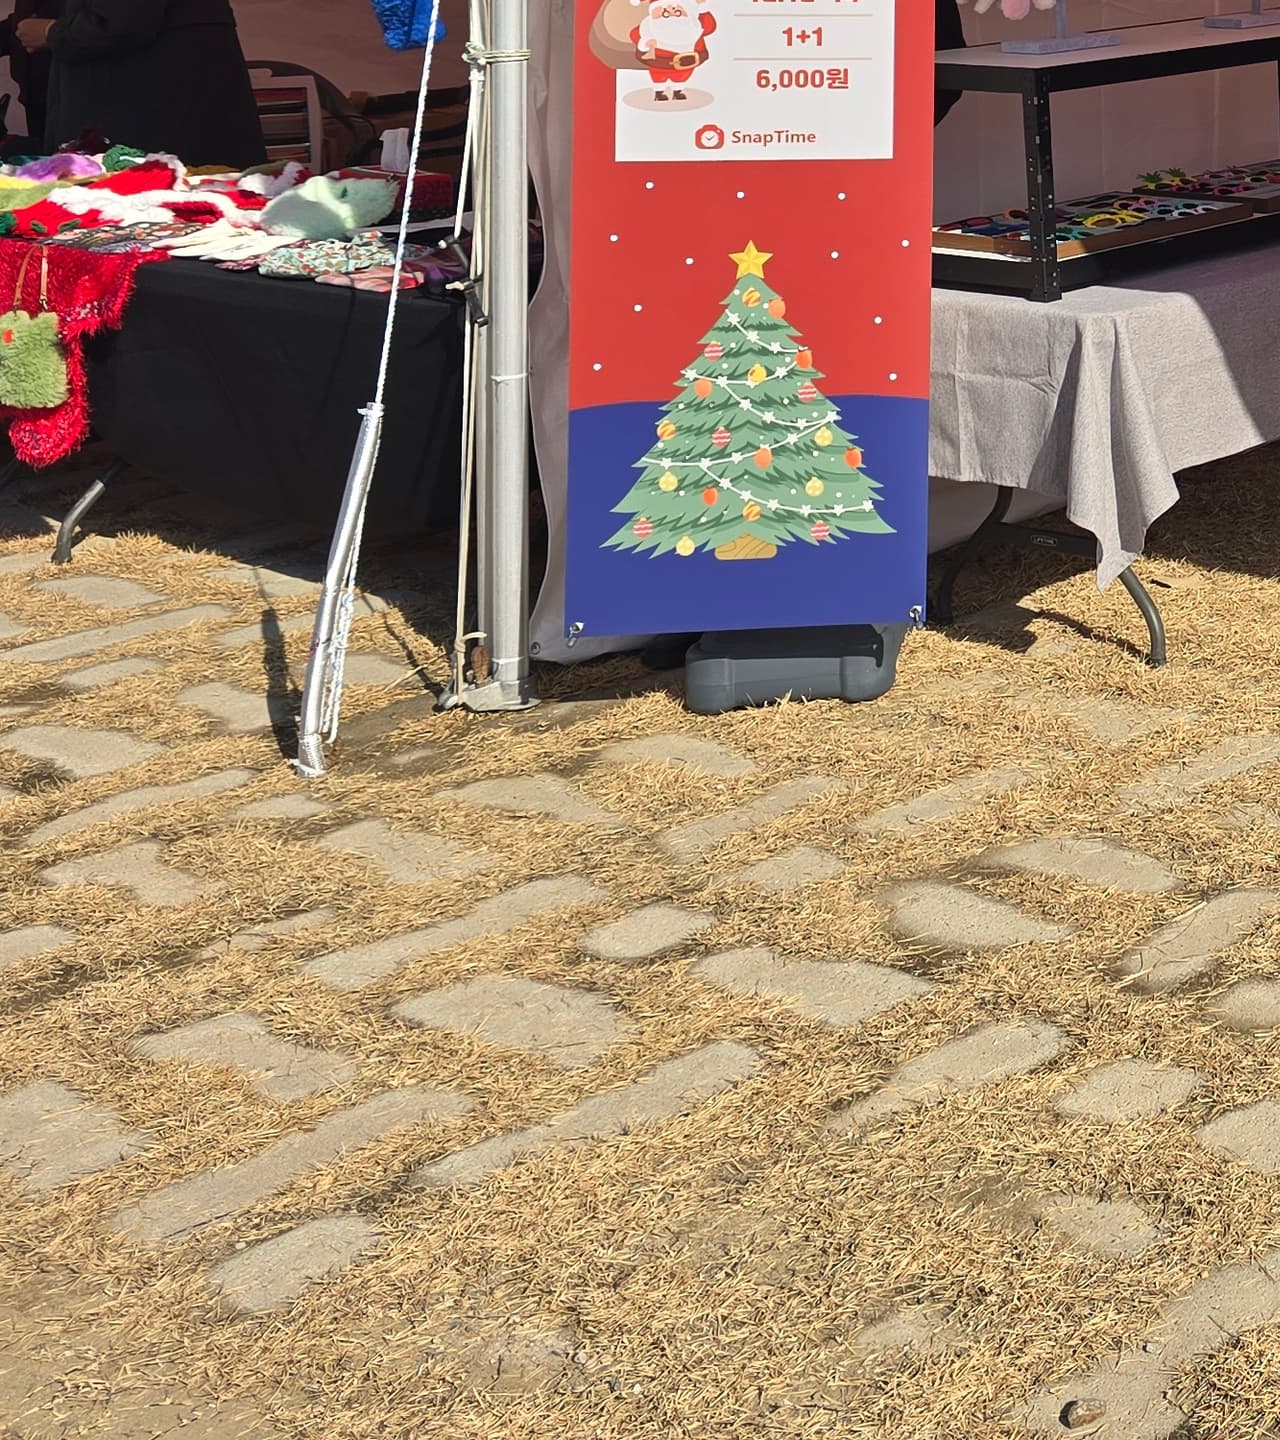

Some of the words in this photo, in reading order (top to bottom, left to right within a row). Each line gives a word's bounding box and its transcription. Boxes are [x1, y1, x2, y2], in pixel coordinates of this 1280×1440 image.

[782, 27, 823, 46] 1+1
[756, 68, 849, 92] 6,000원
[732, 130, 817, 148] SnapTime
